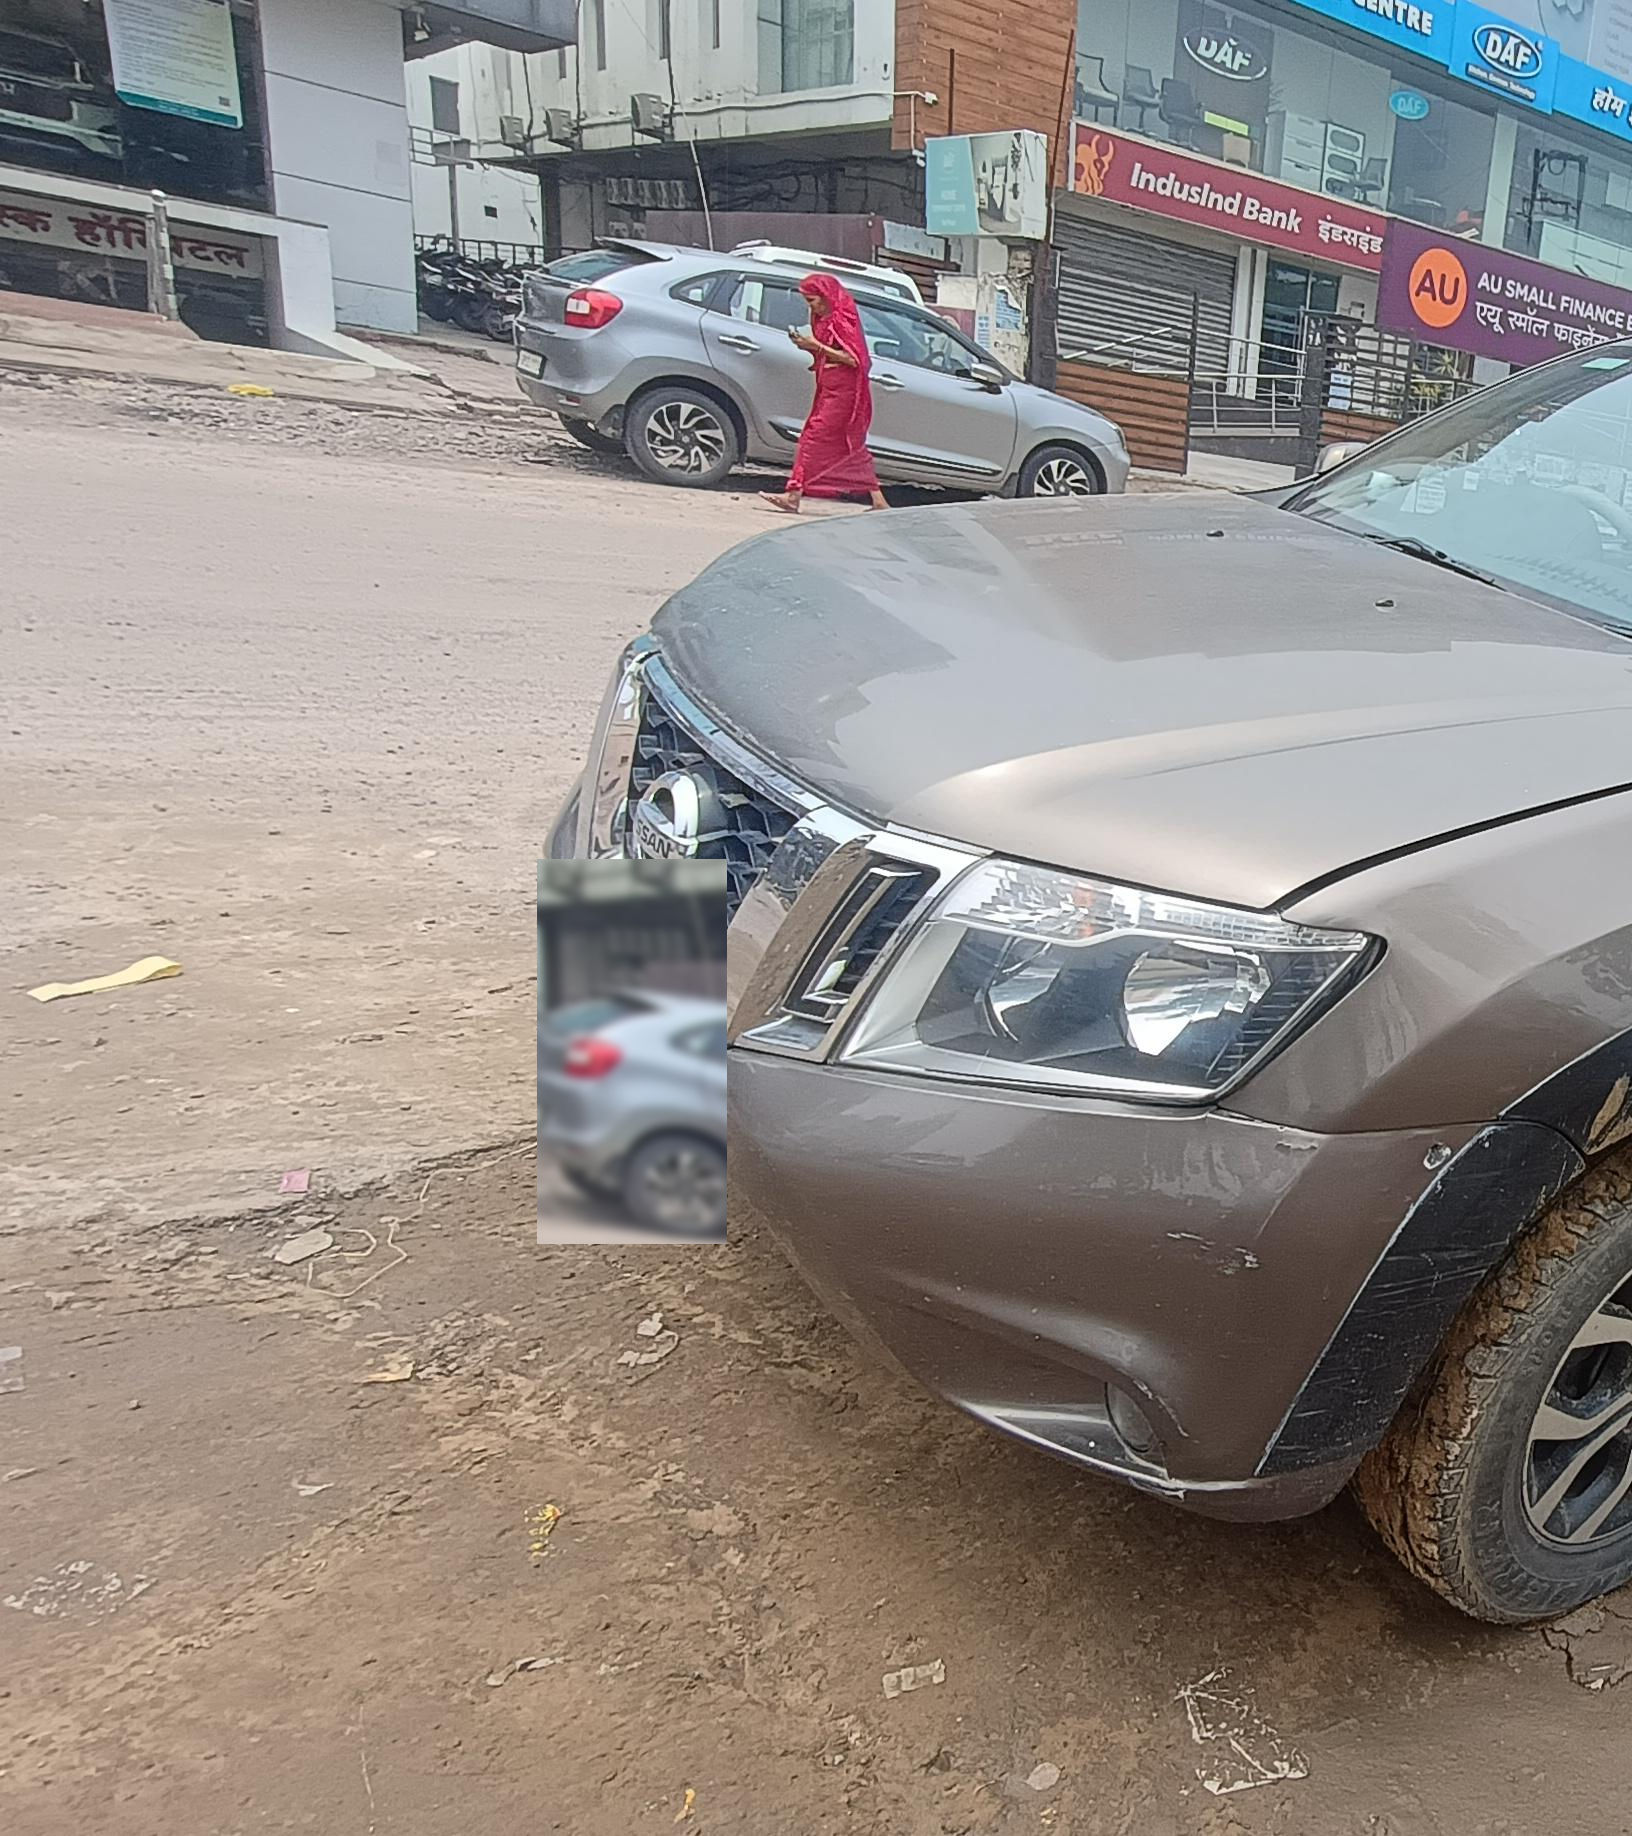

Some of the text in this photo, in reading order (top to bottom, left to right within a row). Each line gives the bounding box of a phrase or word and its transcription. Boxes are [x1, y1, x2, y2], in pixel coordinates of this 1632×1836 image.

[1486, 31, 1532, 71] DAF
[1398, 97, 1423, 114] DAF
[1592, 85, 1625, 118] होम
[1130, 162, 1303, 234] IndusInd Bank
[1317, 213, 1384, 255] इंडसइंड
[1414, 268, 1461, 306] AU
[1476, 272, 1503, 293] AU
[1504, 279, 1557, 311] SMALL
[1560, 295, 1626, 329] FINANCE
[1475, 300, 1505, 335] एयू
[1507, 306, 1550, 338] स्मॉल
[635, 819, 672, 859] SSAN
